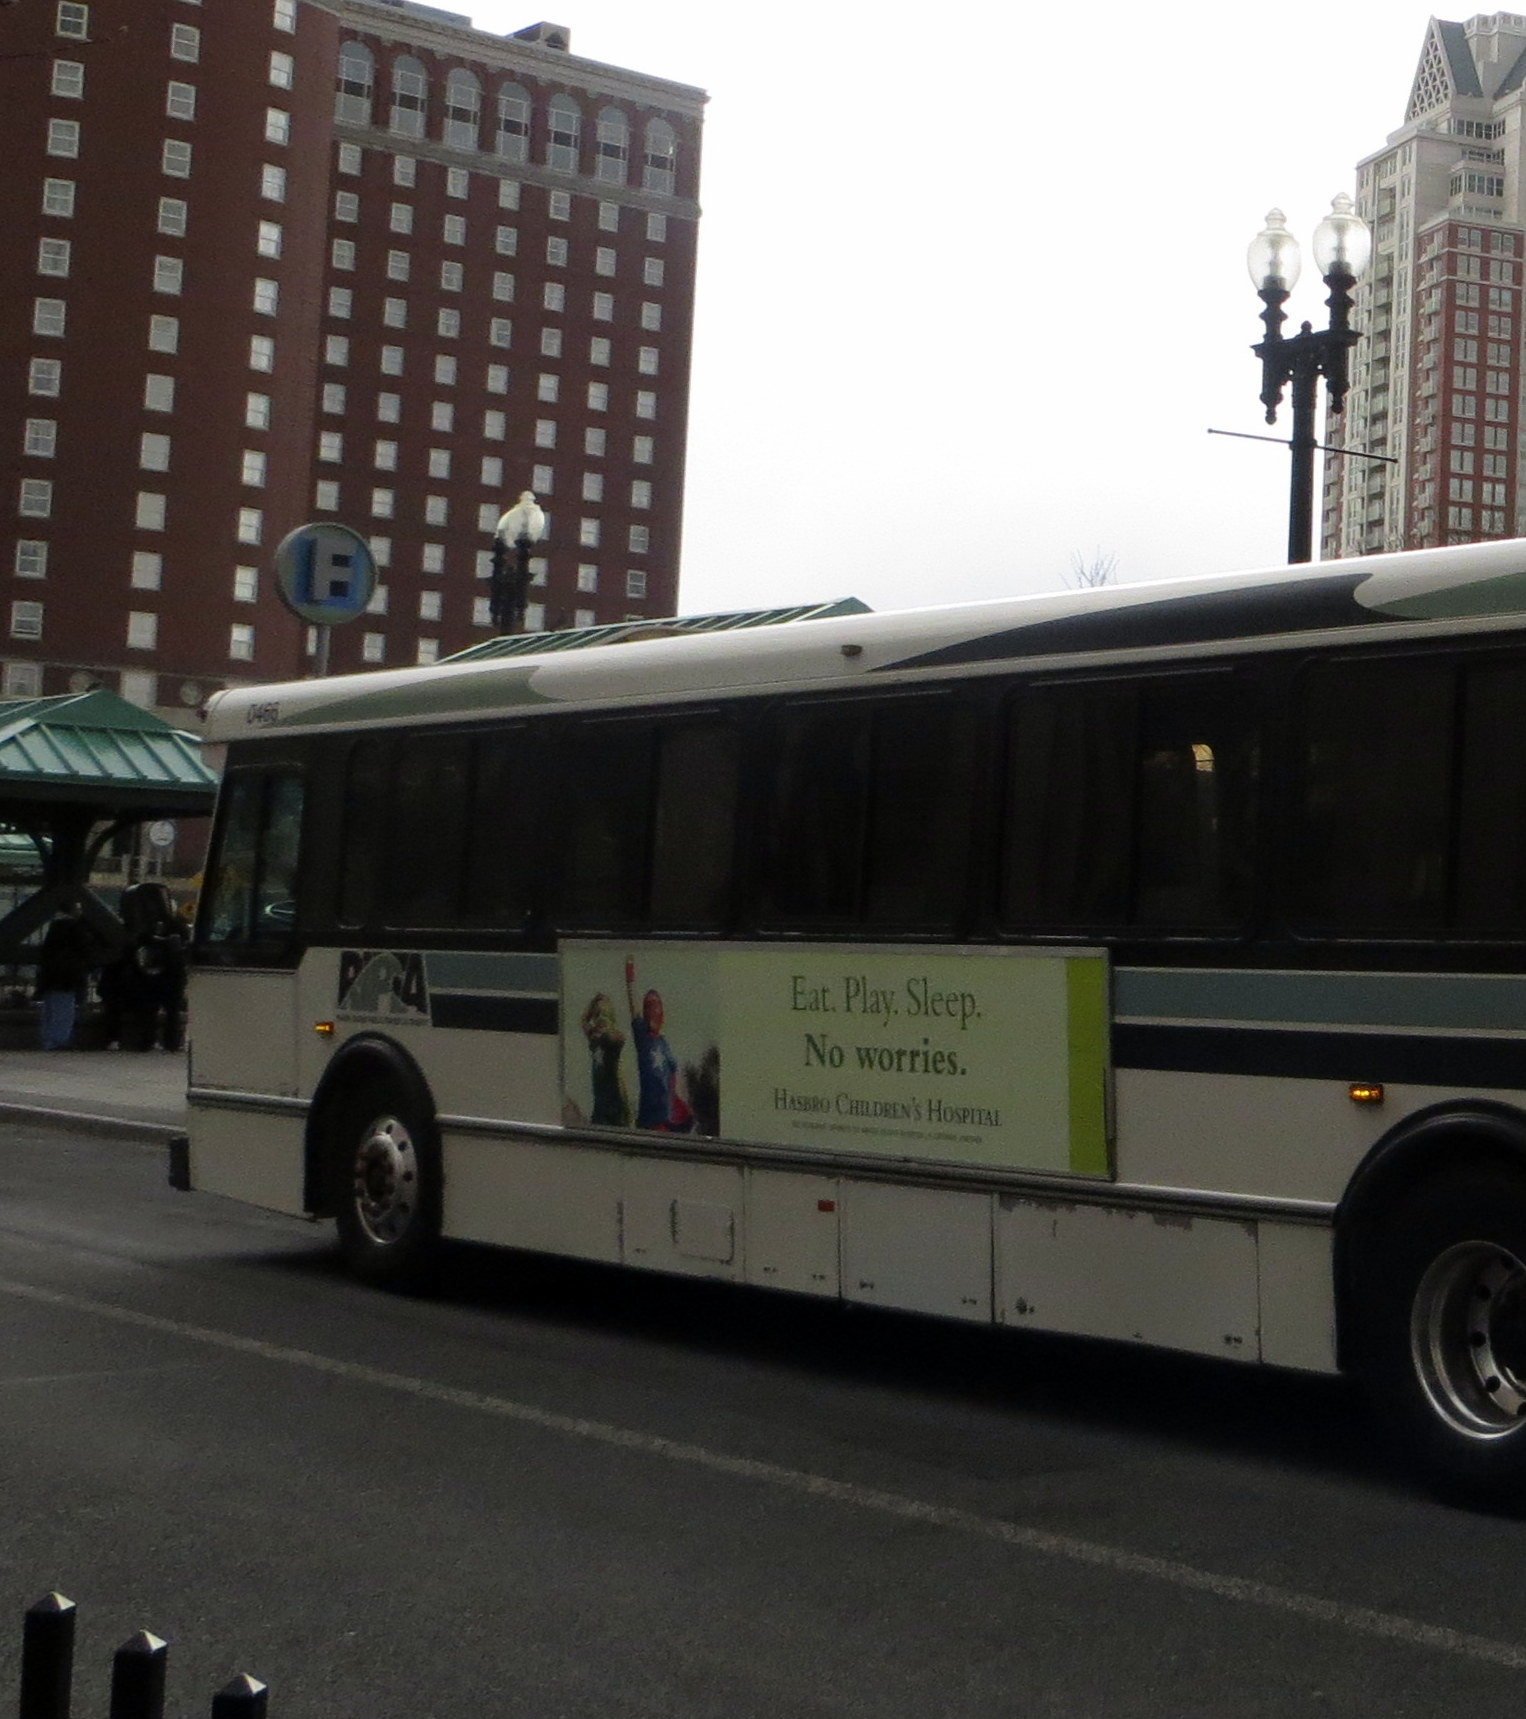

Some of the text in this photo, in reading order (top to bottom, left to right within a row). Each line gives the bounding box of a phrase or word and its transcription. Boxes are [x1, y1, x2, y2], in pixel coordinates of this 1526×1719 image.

[247, 702, 280, 724] 0466
[791, 975, 982, 1030] Eat. Play. Sleep.
[804, 1033, 967, 1076] No worries.
[774, 1088, 831, 1114] HASBRO
[928, 1099, 1002, 1127] HOSPITAL
